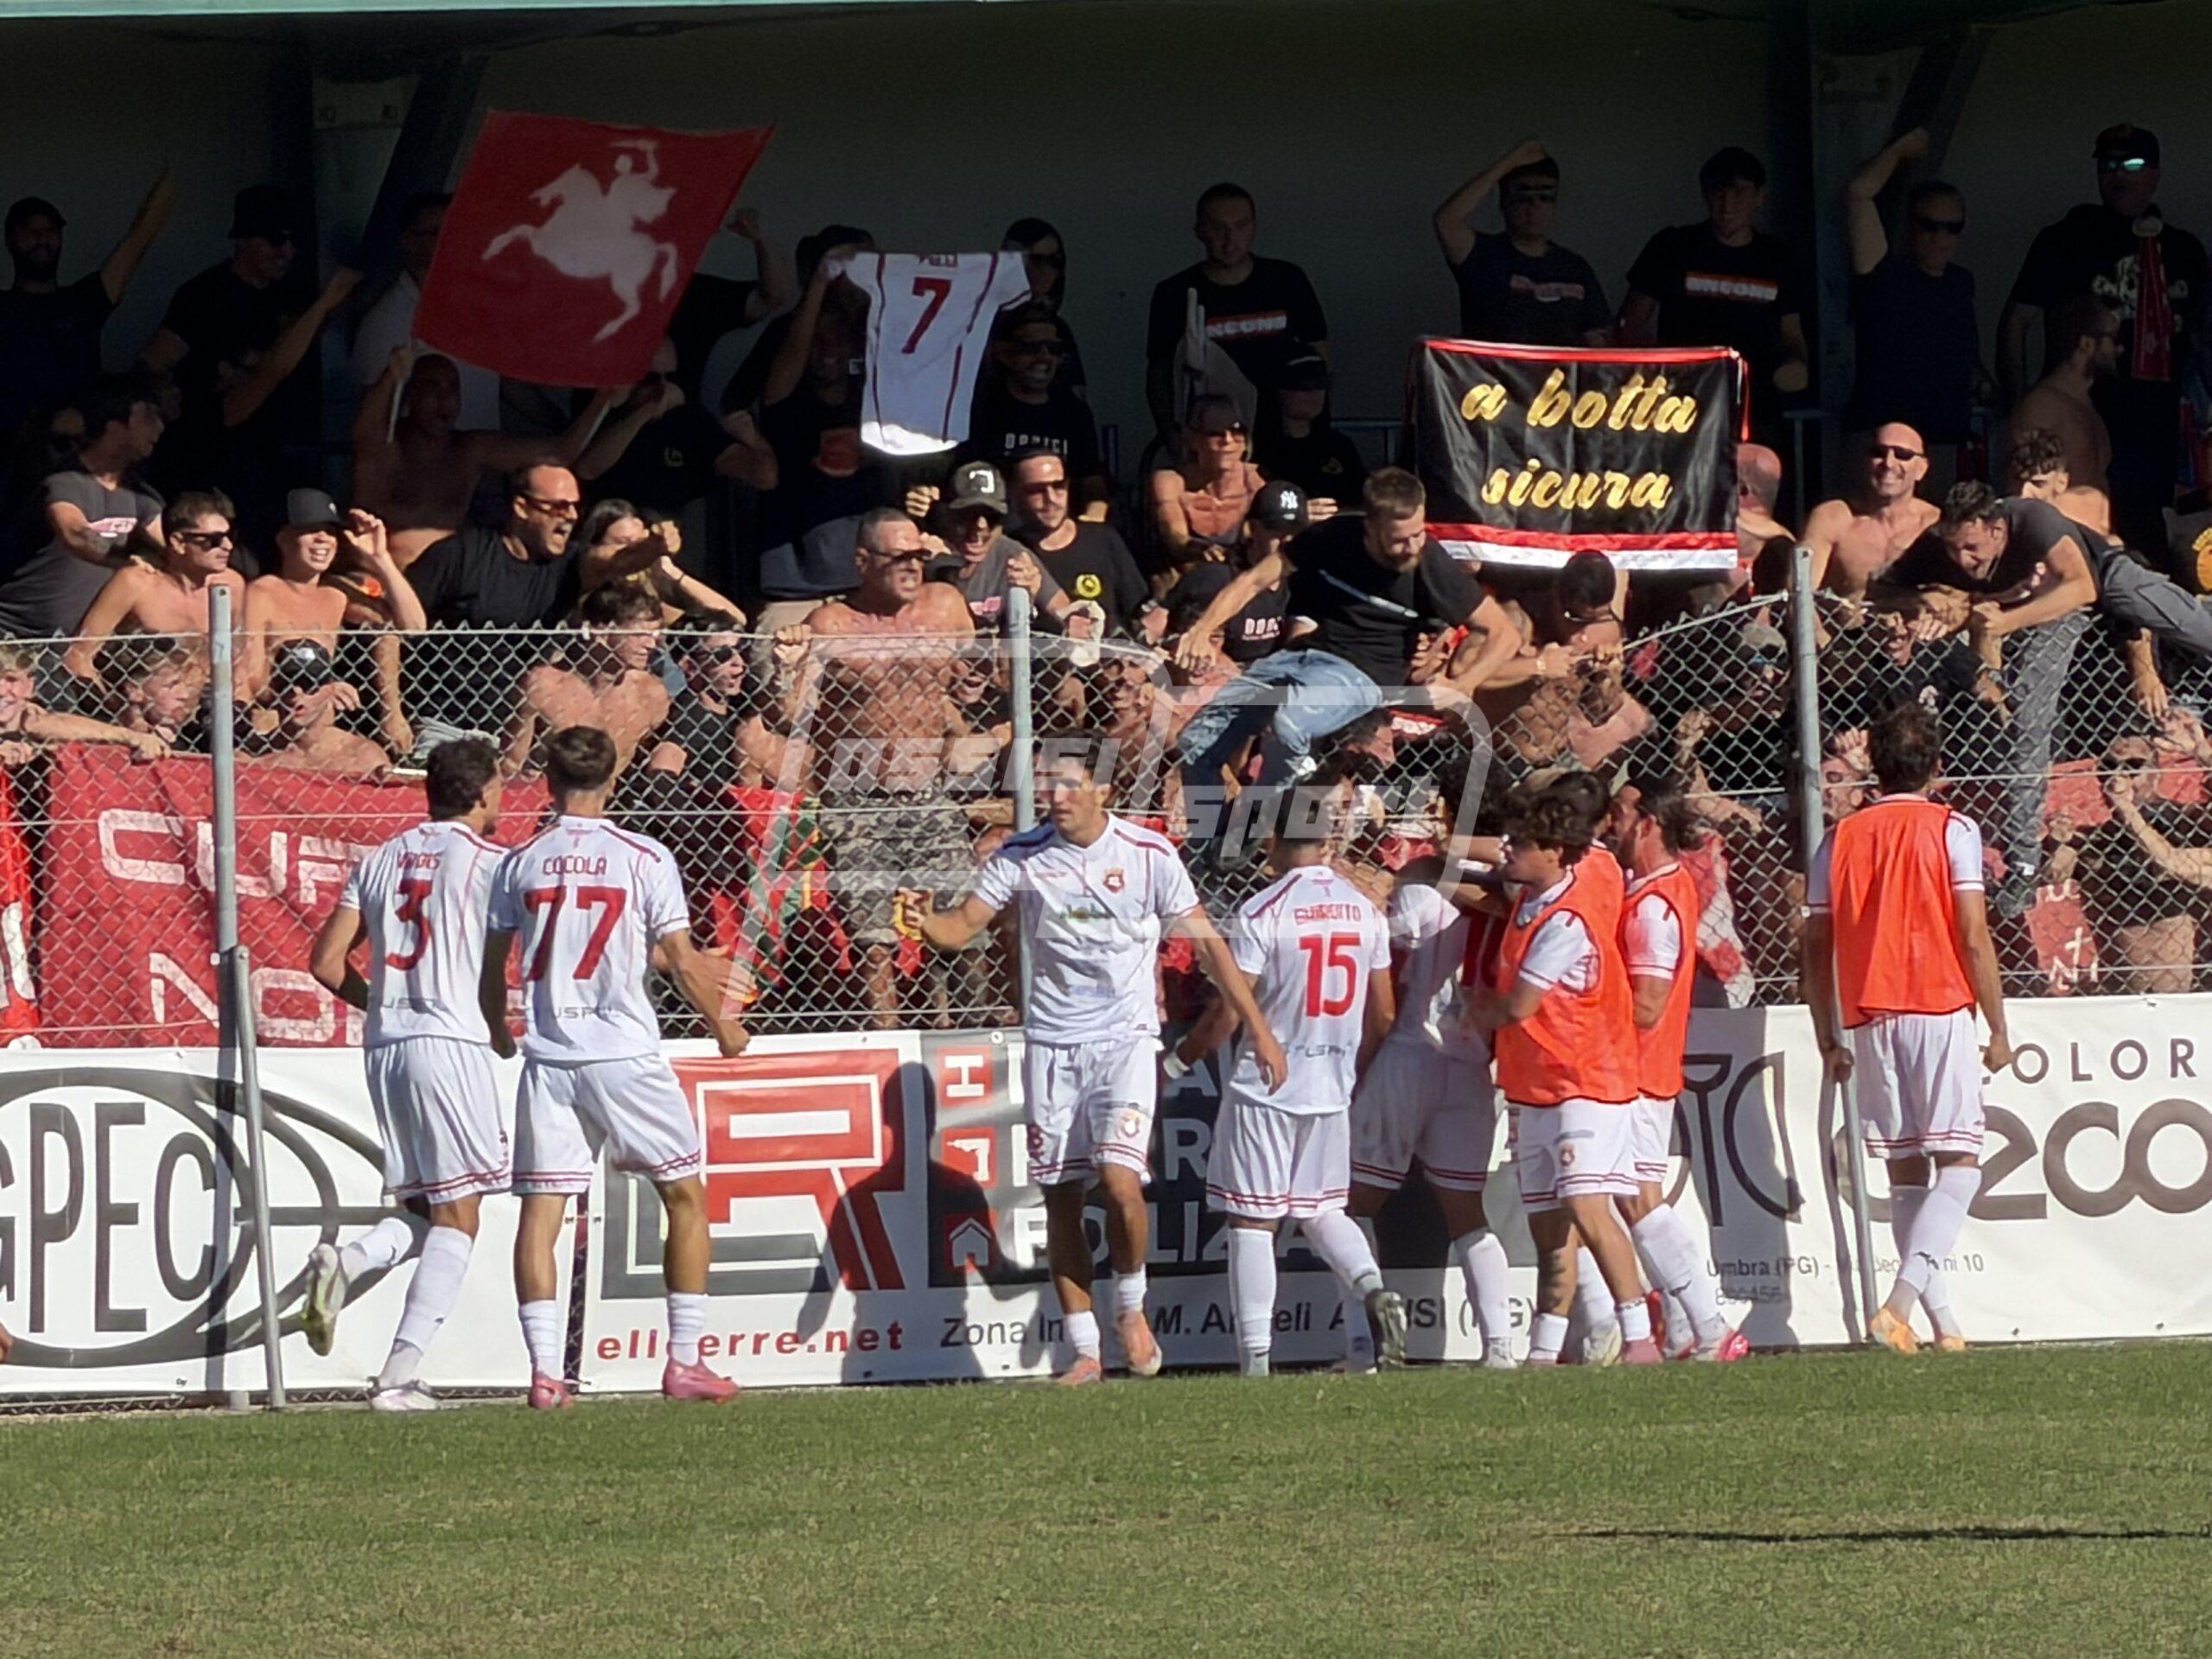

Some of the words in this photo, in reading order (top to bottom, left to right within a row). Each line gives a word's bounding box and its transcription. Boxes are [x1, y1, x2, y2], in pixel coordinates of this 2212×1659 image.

[901, 276, 953, 355] 7
[1460, 383, 1508, 421] a
[1526, 368, 1698, 433] botta
[1481, 458, 1674, 509] sicura
[543, 855, 607, 875] COCOLA
[385, 879, 433, 970] 3
[522, 885, 627, 982] 77
[1299, 931, 1362, 1018] 15
[1980, 1039, 2197, 1084] OLOR
[0, 1103, 217, 1333] PEC
[597, 1319, 903, 1360] ellerre.net
[940, 1317, 1027, 1350] Zona
[1202, 1300, 1312, 1337] Aeli
[1457, 1296, 1533, 1338] (G)
